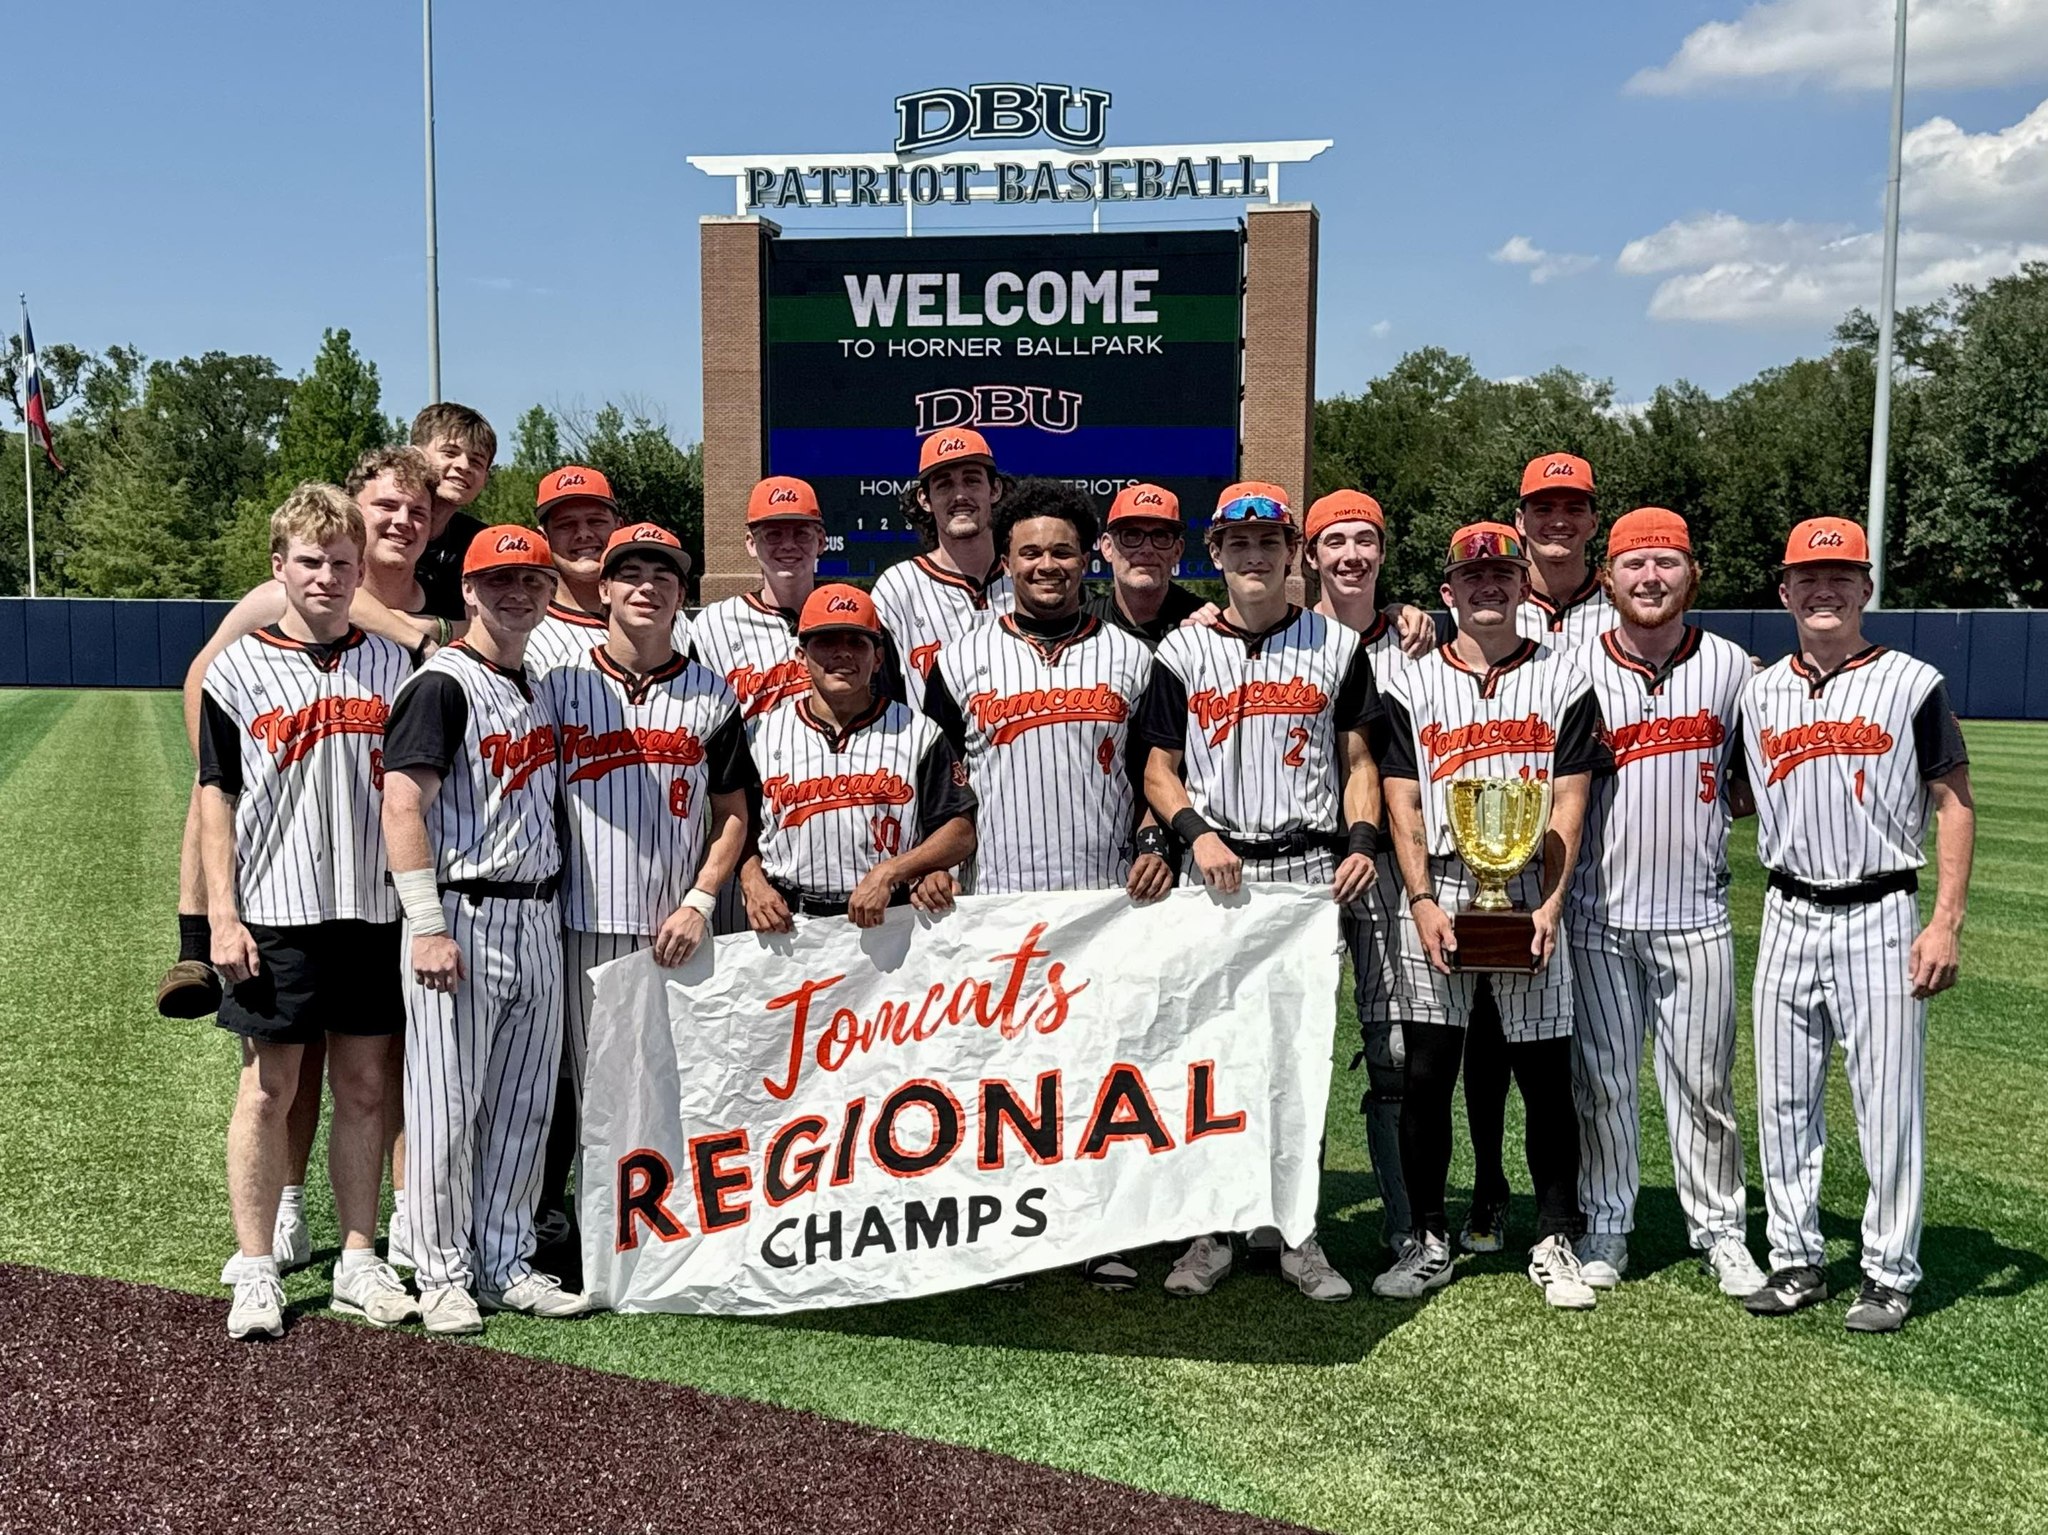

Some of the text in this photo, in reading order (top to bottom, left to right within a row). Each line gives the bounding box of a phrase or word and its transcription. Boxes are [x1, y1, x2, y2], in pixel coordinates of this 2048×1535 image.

[896, 82, 1111, 154] DBU
[745, 153, 1269, 209] PATRIOT BASEBALL
[844, 268, 1160, 328] WELCOME
[839, 334, 1164, 359] TO HORNER BALLPARK
[915, 384, 1083, 437] DBU
[936, 438, 967, 456] Cats
[556, 473, 587, 491] Cats
[1543, 462, 1575, 478] Cats
[769, 487, 799, 506] Cats
[1134, 491, 1164, 506] Cats
[1333, 508, 1372, 518] TOMCATS
[496, 534, 531, 554] Cats
[631, 526, 665, 542] Cats
[857, 517, 863, 530] 1
[880, 517, 889, 530] 2
[1629, 535, 1671, 546] TOMCATS
[1808, 531, 1844, 550] Cats
[827, 595, 860, 614] Cats
[969, 683, 1129, 733] Tomcats
[1614, 707, 1726, 750] mcats
[561, 724, 706, 766] Tomcats
[1284, 727, 1310, 768] 2
[1420, 712, 1556, 764] Tomcats
[1759, 715, 1893, 768] Tomcats
[762, 767, 914, 815] Tomcats
[1699, 761, 1717, 805] 5
[1853, 769, 1866, 806] 1
[870, 814, 902, 858] 10
[763, 921, 1091, 1100] Tomcats
[615, 1058, 1247, 1254] REGIONAL
[761, 1186, 1049, 1269] CHAMPS
